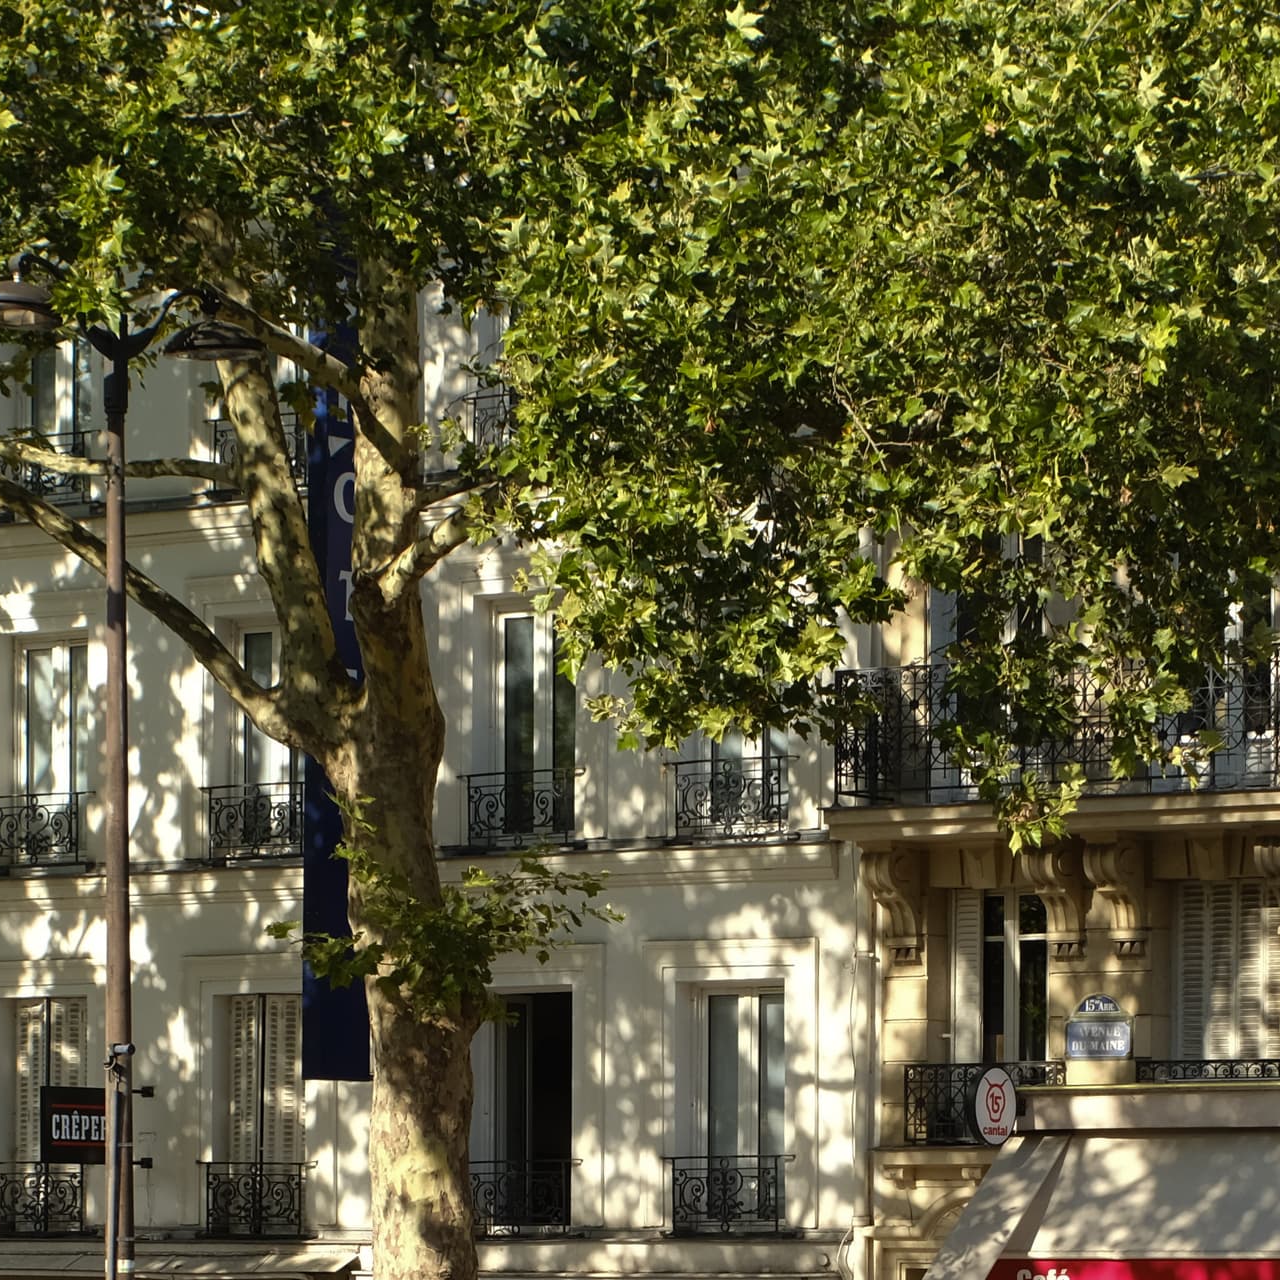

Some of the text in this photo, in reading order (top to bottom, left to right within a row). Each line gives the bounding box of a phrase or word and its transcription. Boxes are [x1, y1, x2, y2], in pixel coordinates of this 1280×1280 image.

[1079, 1025, 1122, 1037] AVENUE
[1071, 1040, 1125, 1051] DU MAINE
[982, 1126, 1008, 1137] cantal
